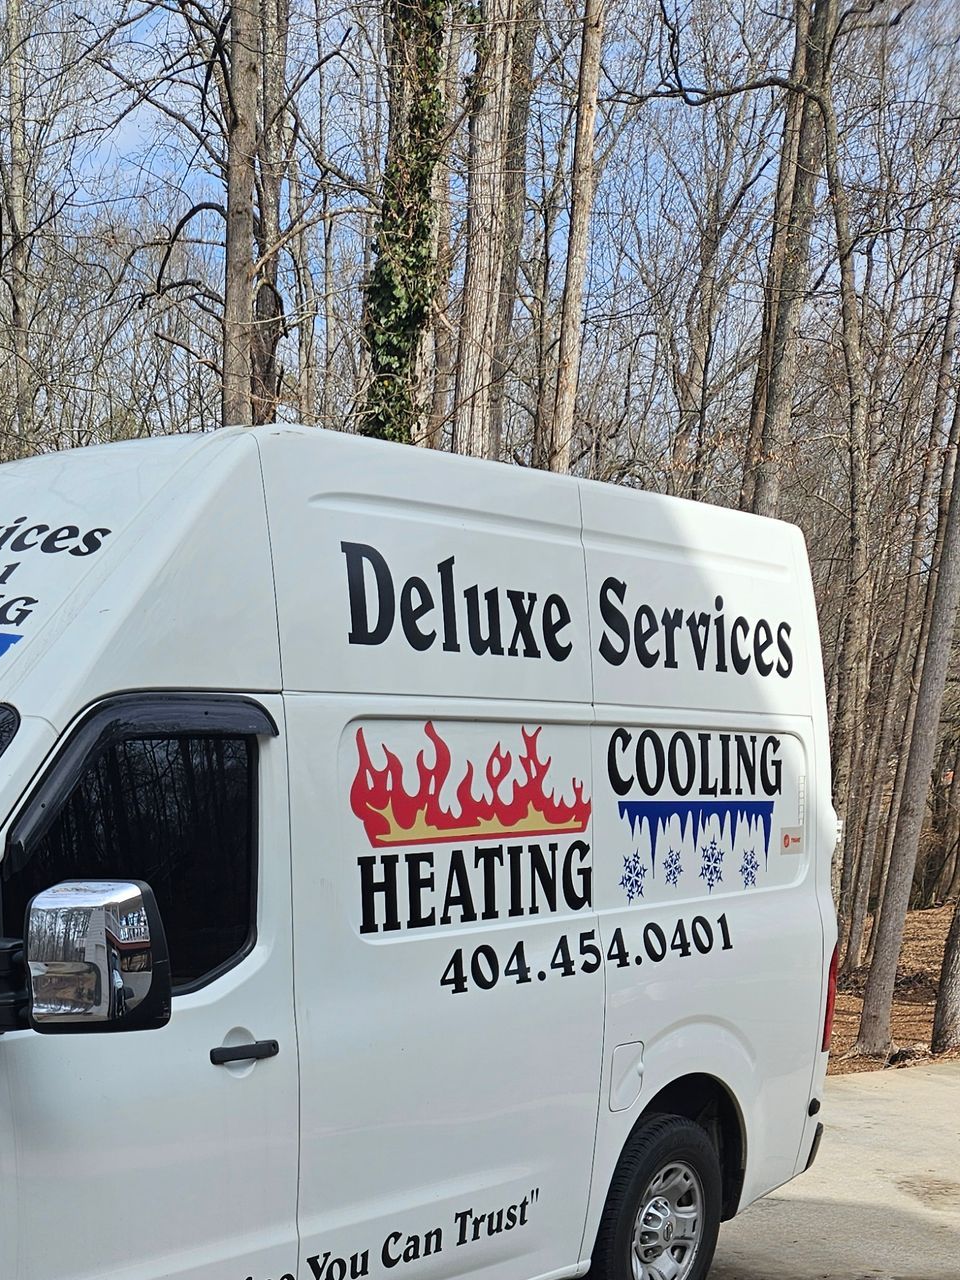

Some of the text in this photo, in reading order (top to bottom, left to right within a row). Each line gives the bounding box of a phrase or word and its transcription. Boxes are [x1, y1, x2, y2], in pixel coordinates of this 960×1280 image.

[340, 541, 793, 679] Deluxe Services
[607, 728, 783, 798] COOLING
[357, 840, 592, 935] HEATING
[440, 913, 733, 995] 404.454.0401
[381, 1227, 443, 1269] Can
[454, 1187, 540, 1247] Trust"
